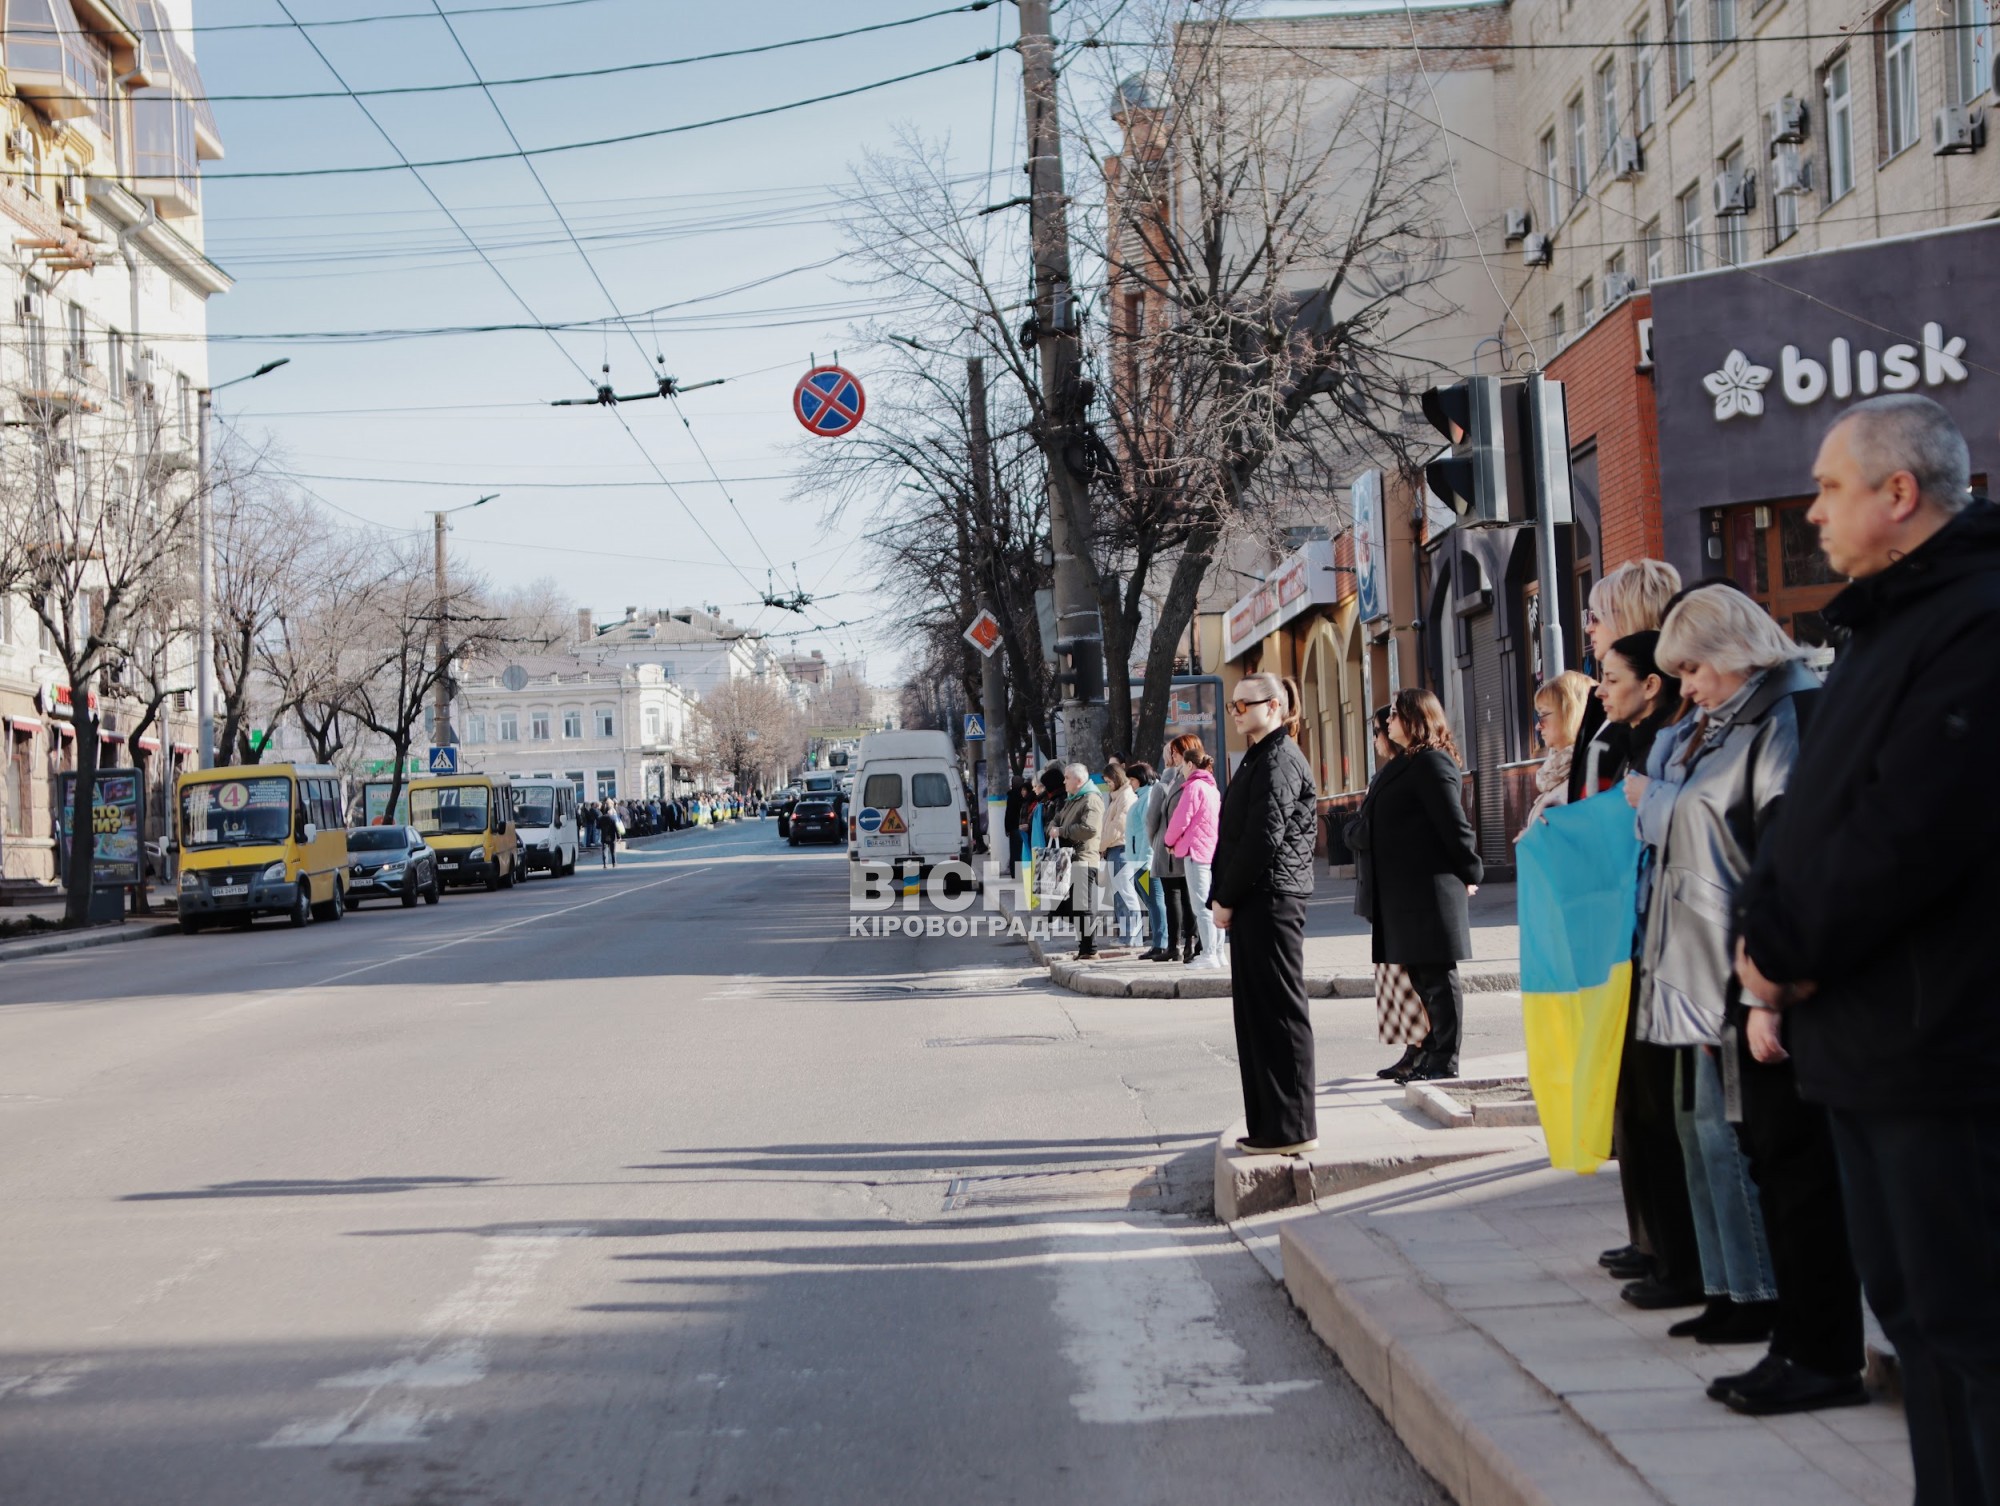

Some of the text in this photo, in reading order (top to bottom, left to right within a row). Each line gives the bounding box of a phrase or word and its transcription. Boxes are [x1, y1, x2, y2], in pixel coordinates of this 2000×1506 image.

[1781, 321, 1968, 405] blisk
[223, 785, 240, 807] 4
[439, 789, 458, 807] 77
[511, 789, 527, 805] 21
